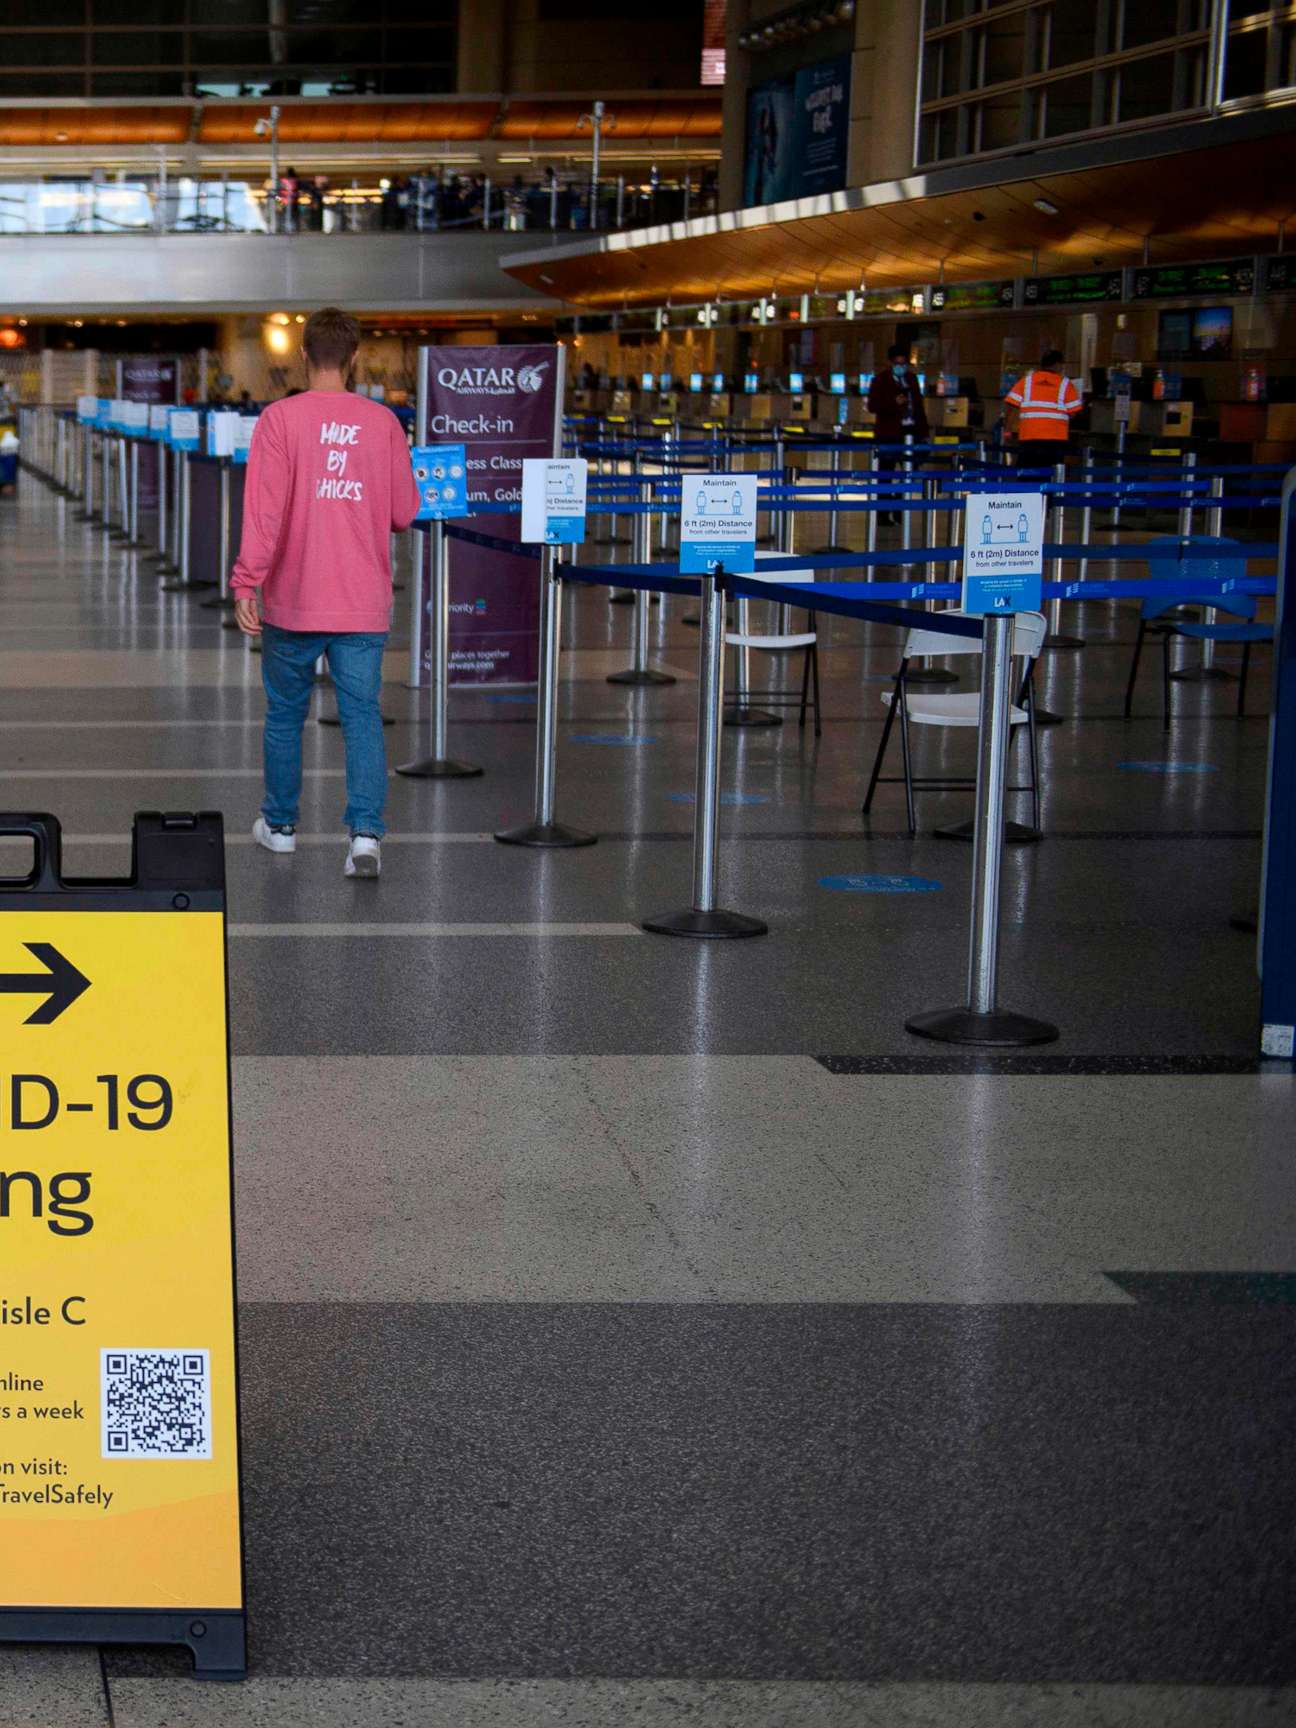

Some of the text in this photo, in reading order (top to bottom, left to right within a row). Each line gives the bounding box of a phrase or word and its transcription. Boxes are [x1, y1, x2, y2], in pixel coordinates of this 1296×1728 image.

[437, 367, 515, 391] QATAR
[431, 414, 514, 434] Check-in
[327, 449, 347, 477] BY
[702, 479, 737, 487] Maintain
[988, 500, 1022, 509] Maintain
[699, 519, 716, 528] (2m)
[718, 519, 753, 527] Distance
[970, 548, 1039, 560] 6 ft (2m) Distance
[448, 602, 474, 616] riority
[61, 1296, 86, 1326] C
[17, 1407, 27, 1419] a
[33, 1400, 84, 1419] week
[20, 1458, 70, 1475] visit:
